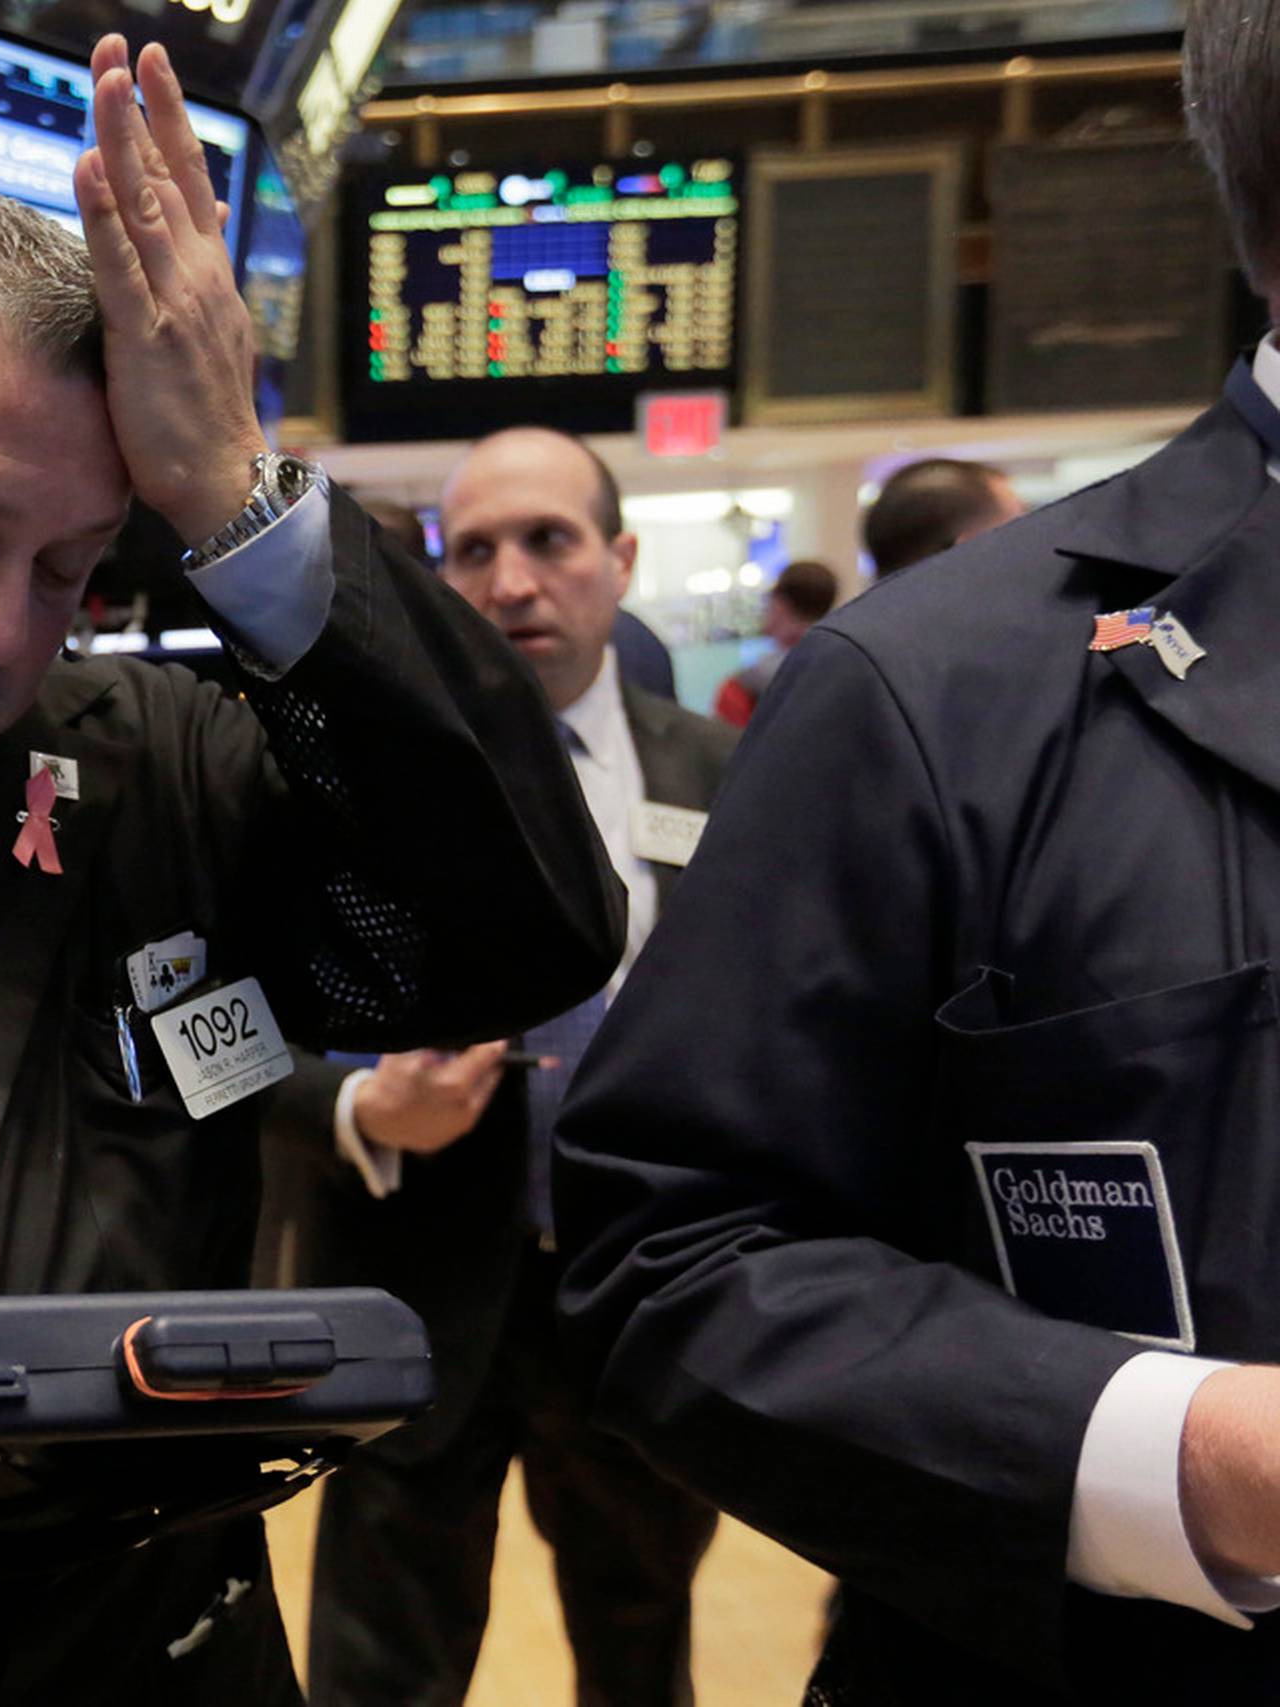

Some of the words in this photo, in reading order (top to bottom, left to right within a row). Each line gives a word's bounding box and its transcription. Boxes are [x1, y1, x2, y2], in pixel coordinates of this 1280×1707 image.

[179, 998, 258, 1061] 1092
[992, 1168, 1154, 1208] Goldman
[1006, 1201, 1107, 1240] Sachs
